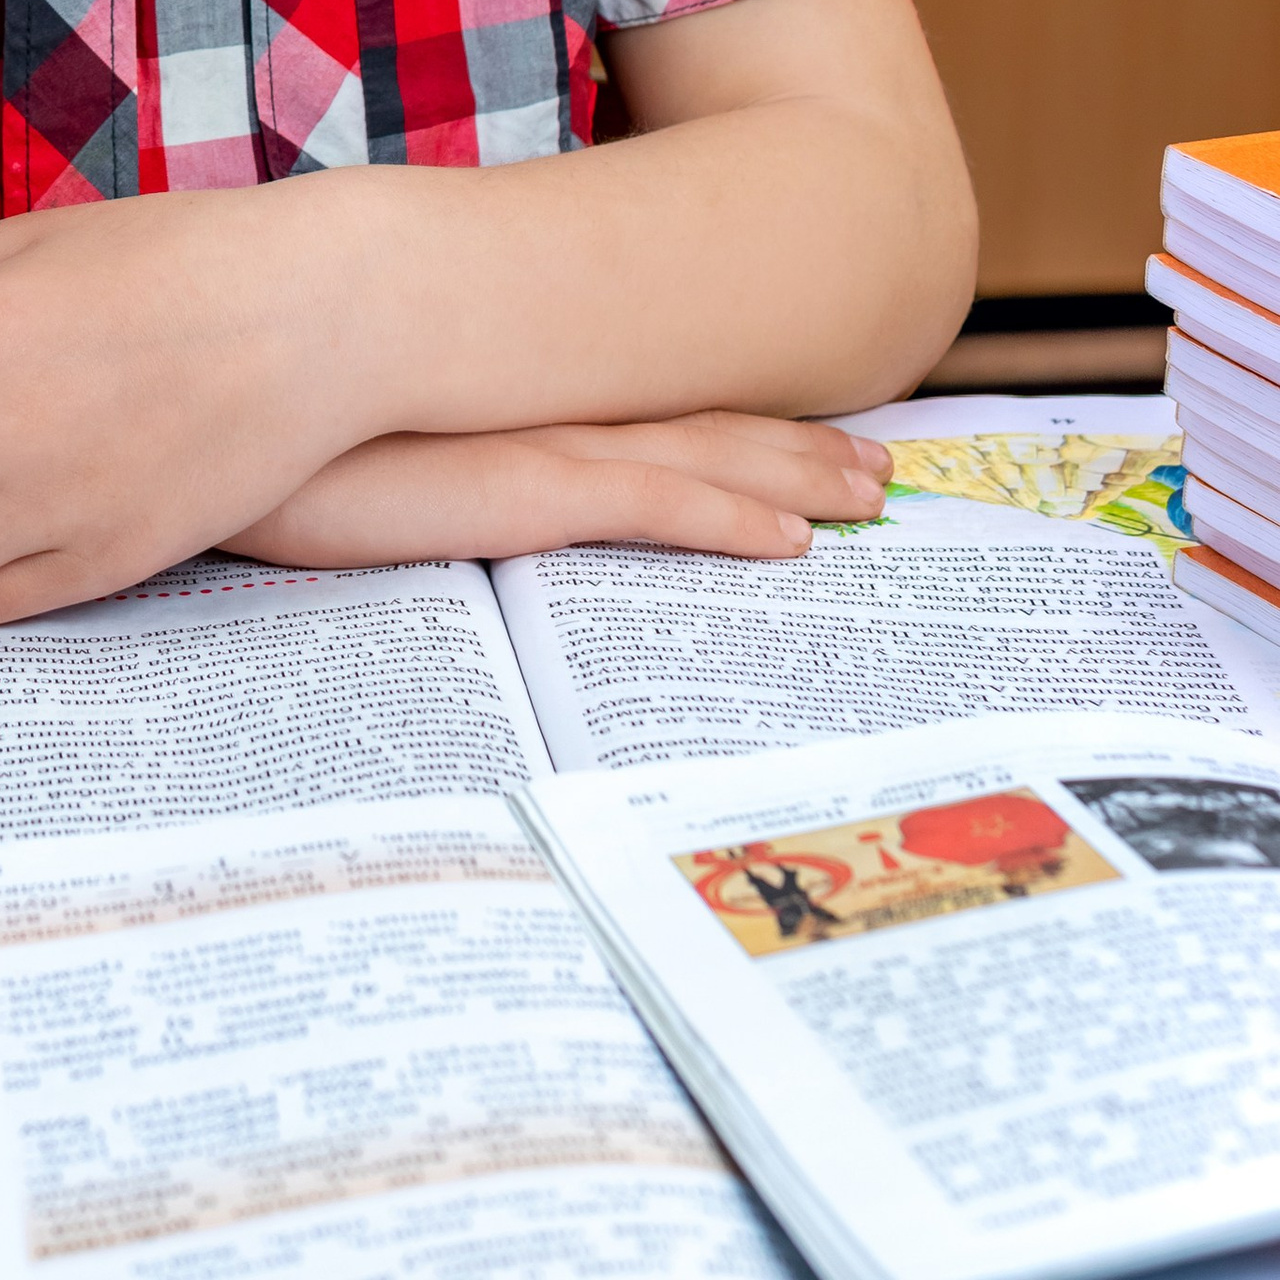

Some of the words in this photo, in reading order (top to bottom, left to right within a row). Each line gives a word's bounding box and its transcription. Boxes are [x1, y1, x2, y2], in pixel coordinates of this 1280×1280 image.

[1063, 547, 1118, 555] этом
[996, 556, 1066, 564] греки
[1098, 559, 1160, 569] рево,
[334, 562, 451, 579] Вопросы
[820, 564, 900, 573] Афина
[927, 565, 1011, 573] морях,
[1053, 568, 1166, 580] гущество
[276, 598, 402, 620] украшали
[412, 598, 468, 608] Ими
[319, 606, 471, 623] создавались
[422, 616, 439, 624] В
[141, 617, 266, 639] городские
[228, 621, 310, 637] статуи
[335, 619, 403, 630] честь
[328, 630, 395, 641] честь
[426, 625, 478, 637] года
[11, 636, 132, 645] площади,
[100, 639, 181, 653] белого
[158, 630, 317, 656] победителей
[209, 639, 320, 658] главного
[149, 654, 201, 667] бога
[36, 663, 139, 676] древних
